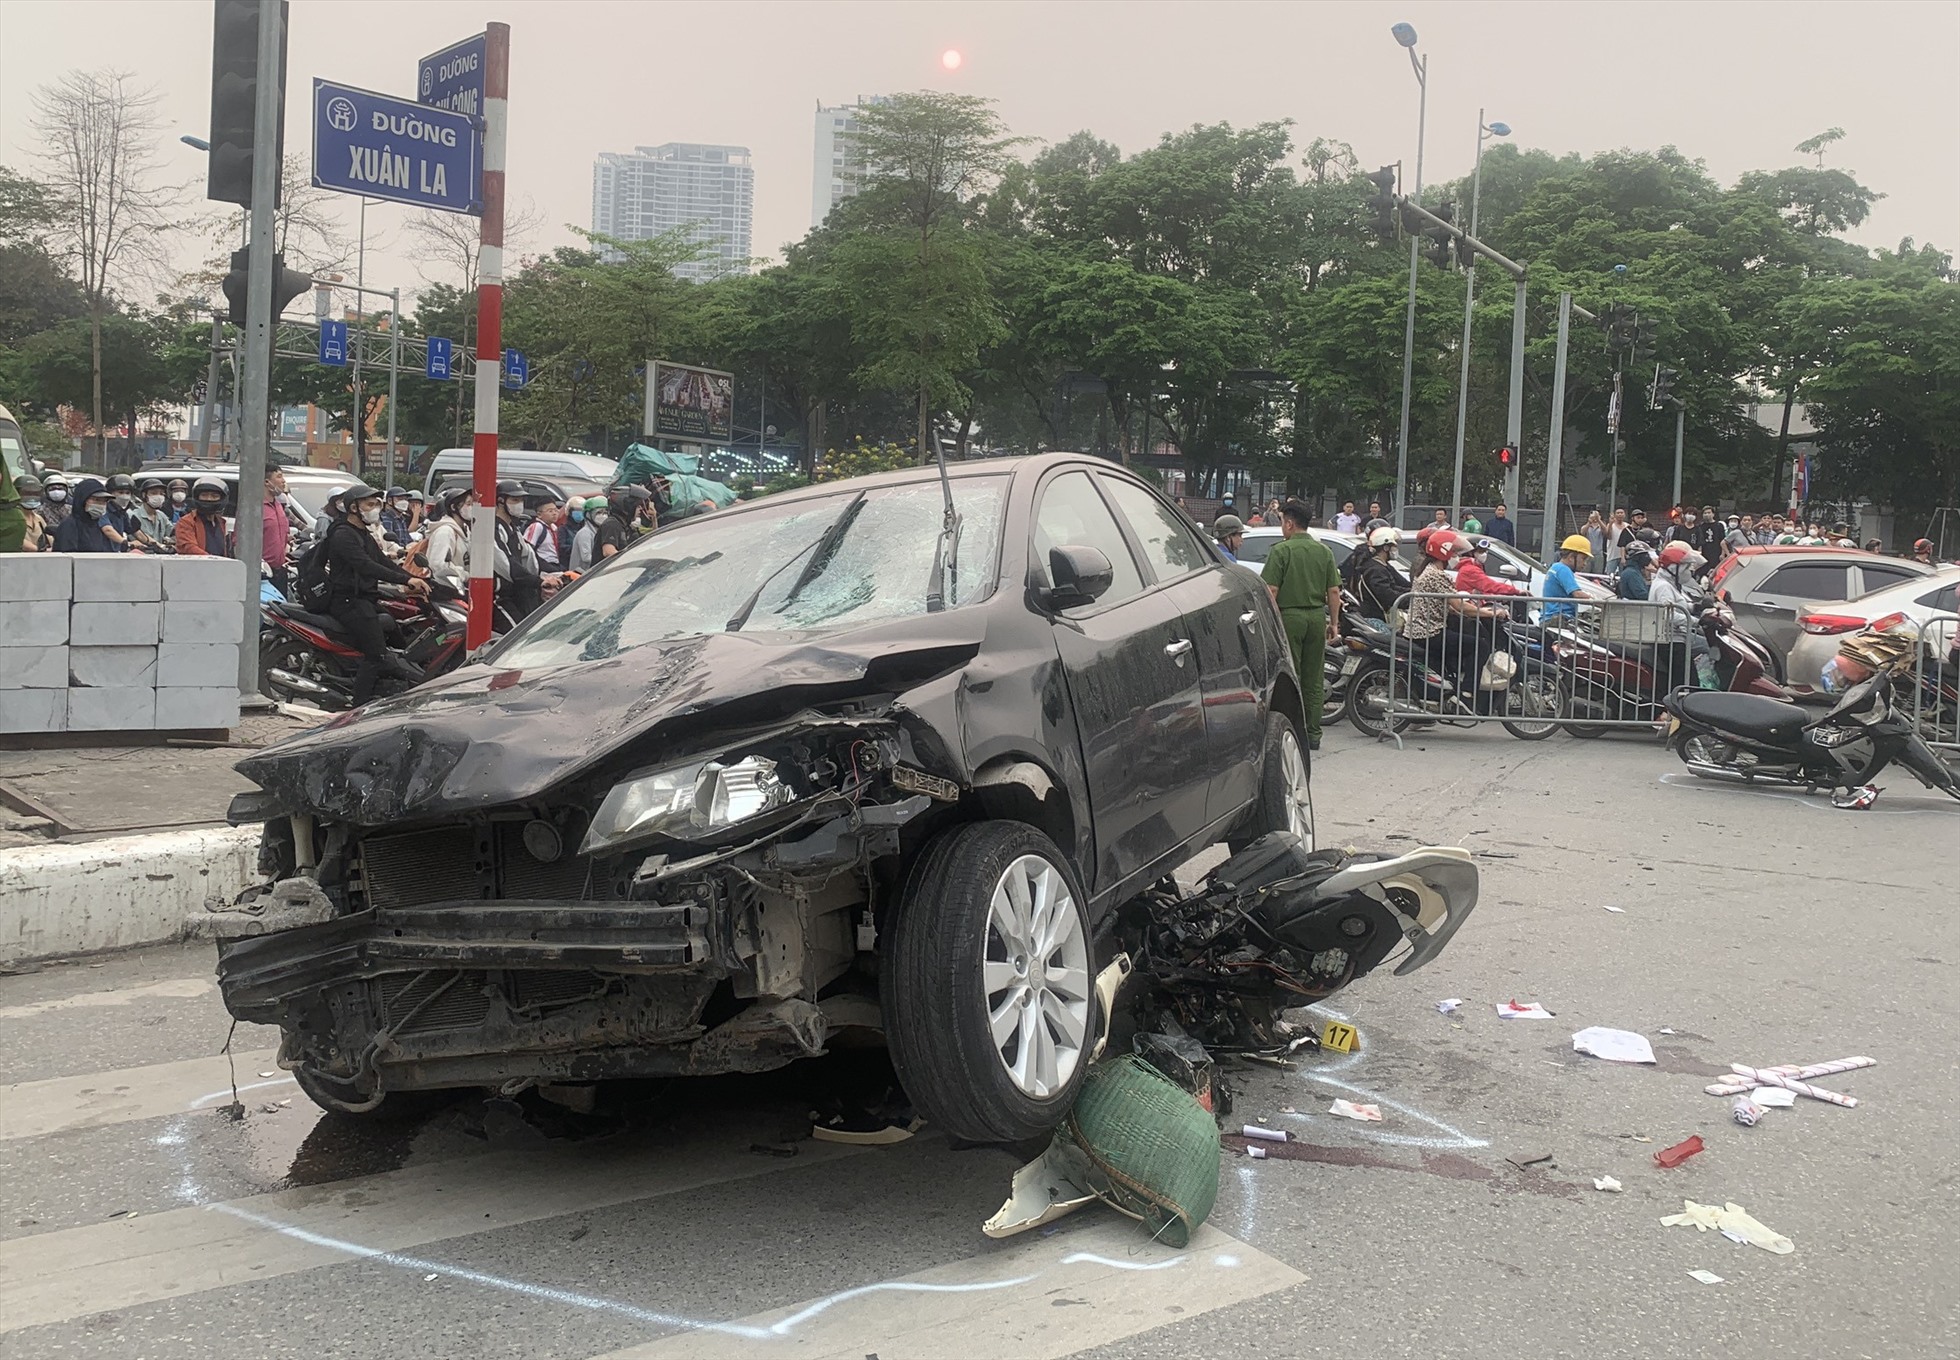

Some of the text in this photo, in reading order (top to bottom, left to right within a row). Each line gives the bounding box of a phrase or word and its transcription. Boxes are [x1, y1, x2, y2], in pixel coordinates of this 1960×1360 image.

[440, 53, 478, 83] ĐƯỜNG
[371, 112, 456, 147] ĐƯỜNG
[349, 144, 447, 197] XUÂN LA
[1329, 1025, 1350, 1047] 17
